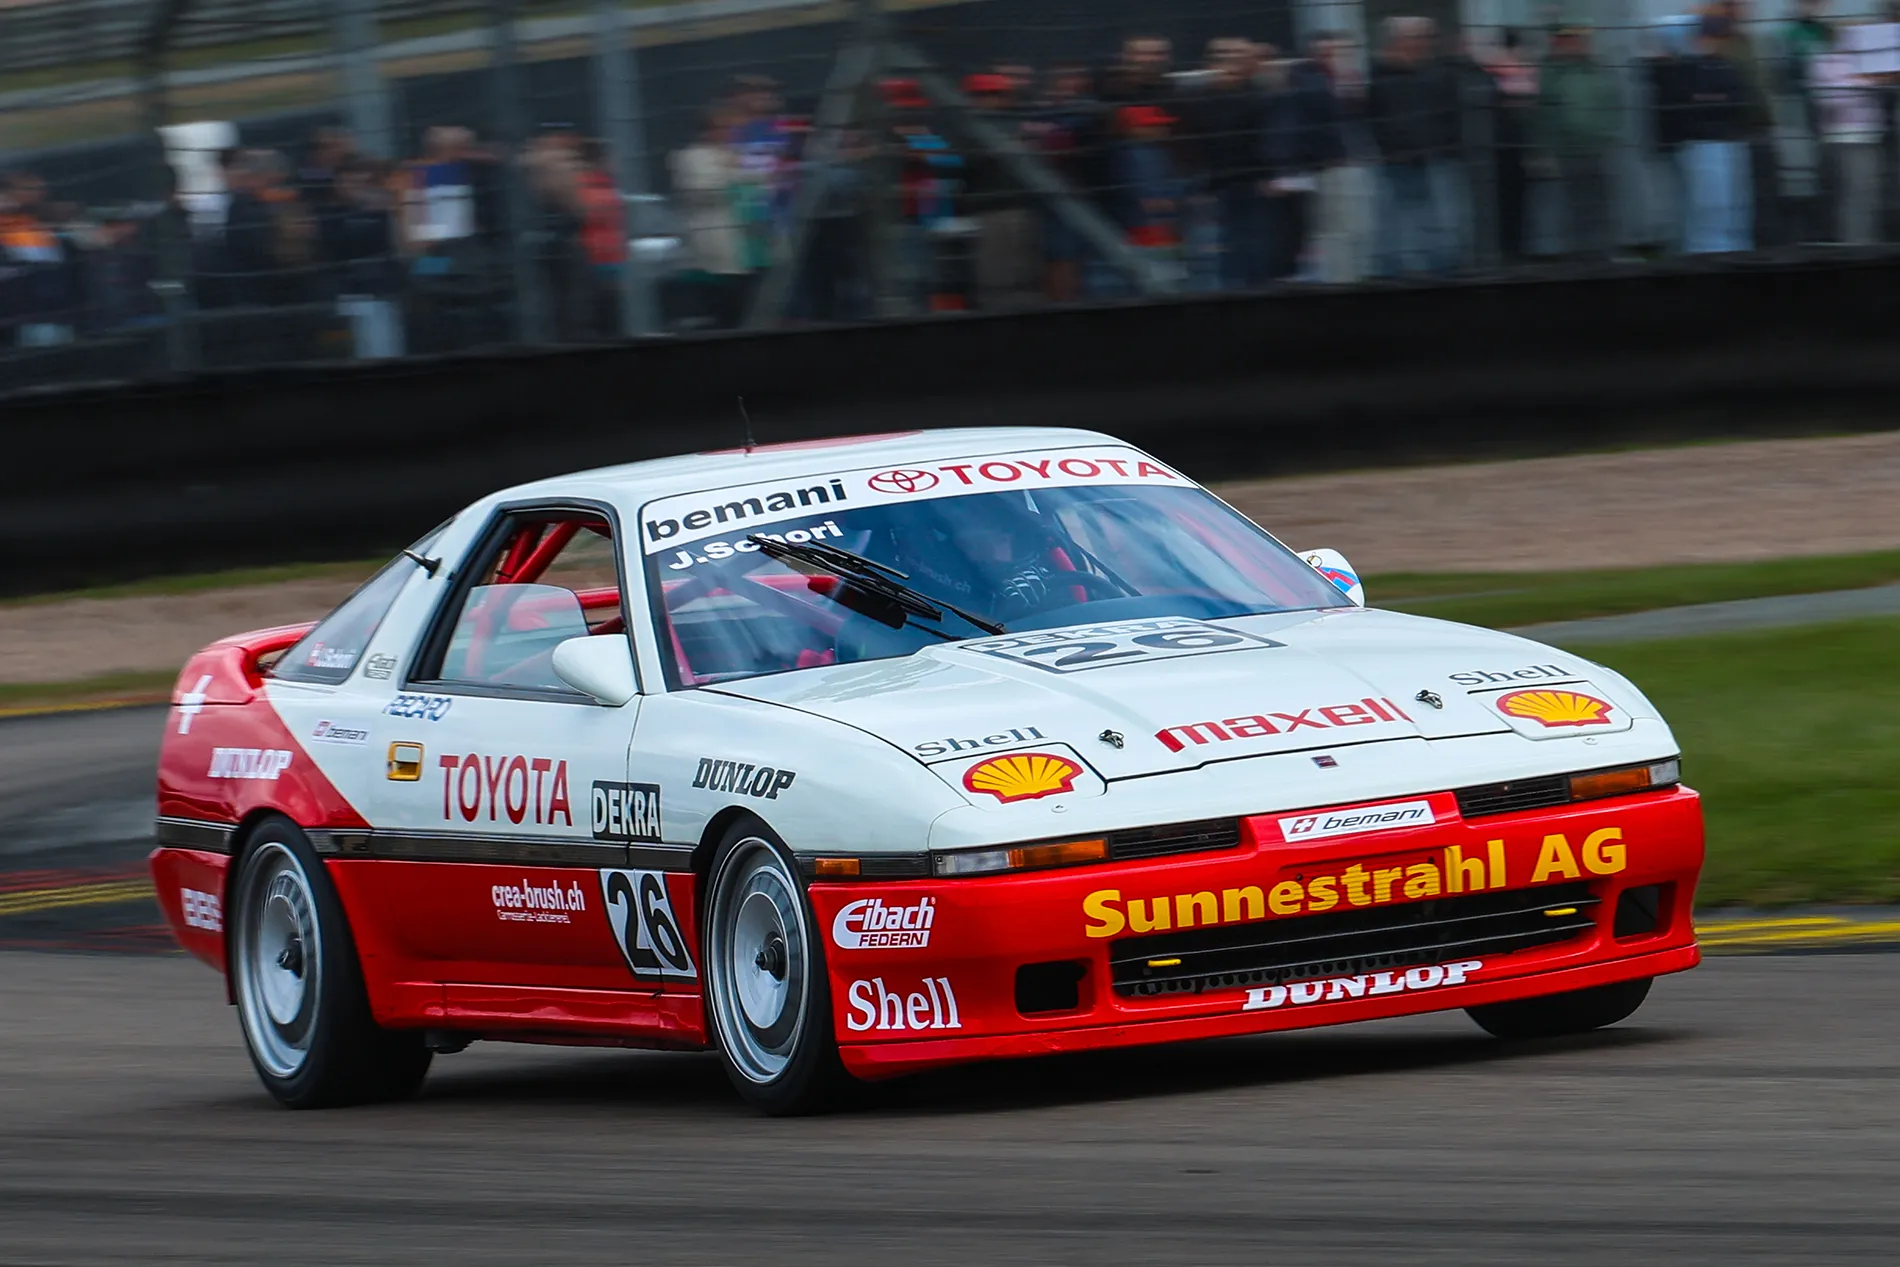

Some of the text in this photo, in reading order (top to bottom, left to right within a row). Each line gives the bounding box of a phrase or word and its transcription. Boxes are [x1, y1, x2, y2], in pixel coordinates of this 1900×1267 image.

[938, 458, 1178, 486] TOYOTA
[646, 477, 848, 543] bemani
[668, 520, 844, 571] J.Schori
[975, 619, 1186, 652] DEKRA
[1023, 630, 1245, 667] 26
[1449, 664, 1573, 687] Shell
[914, 726, 1047, 757] Shell
[1154, 697, 1415, 753] maxell
[207, 747, 294, 779] DUNLOP
[692, 758, 796, 800] DUNLOP
[439, 753, 573, 827] TOYOTA
[593, 788, 661, 837] DEKRA
[1322, 808, 1425, 831] bemani
[491, 878, 586, 911] crea-brush.ch
[1082, 827, 1627, 939] Sunnestrahl AG
[607, 872, 689, 971] 26
[832, 897, 935, 949] Eibach
[859, 932, 924, 947] FEDERN
[847, 977, 962, 1031] Shell
[1242, 961, 1483, 1011] DUNLOP
